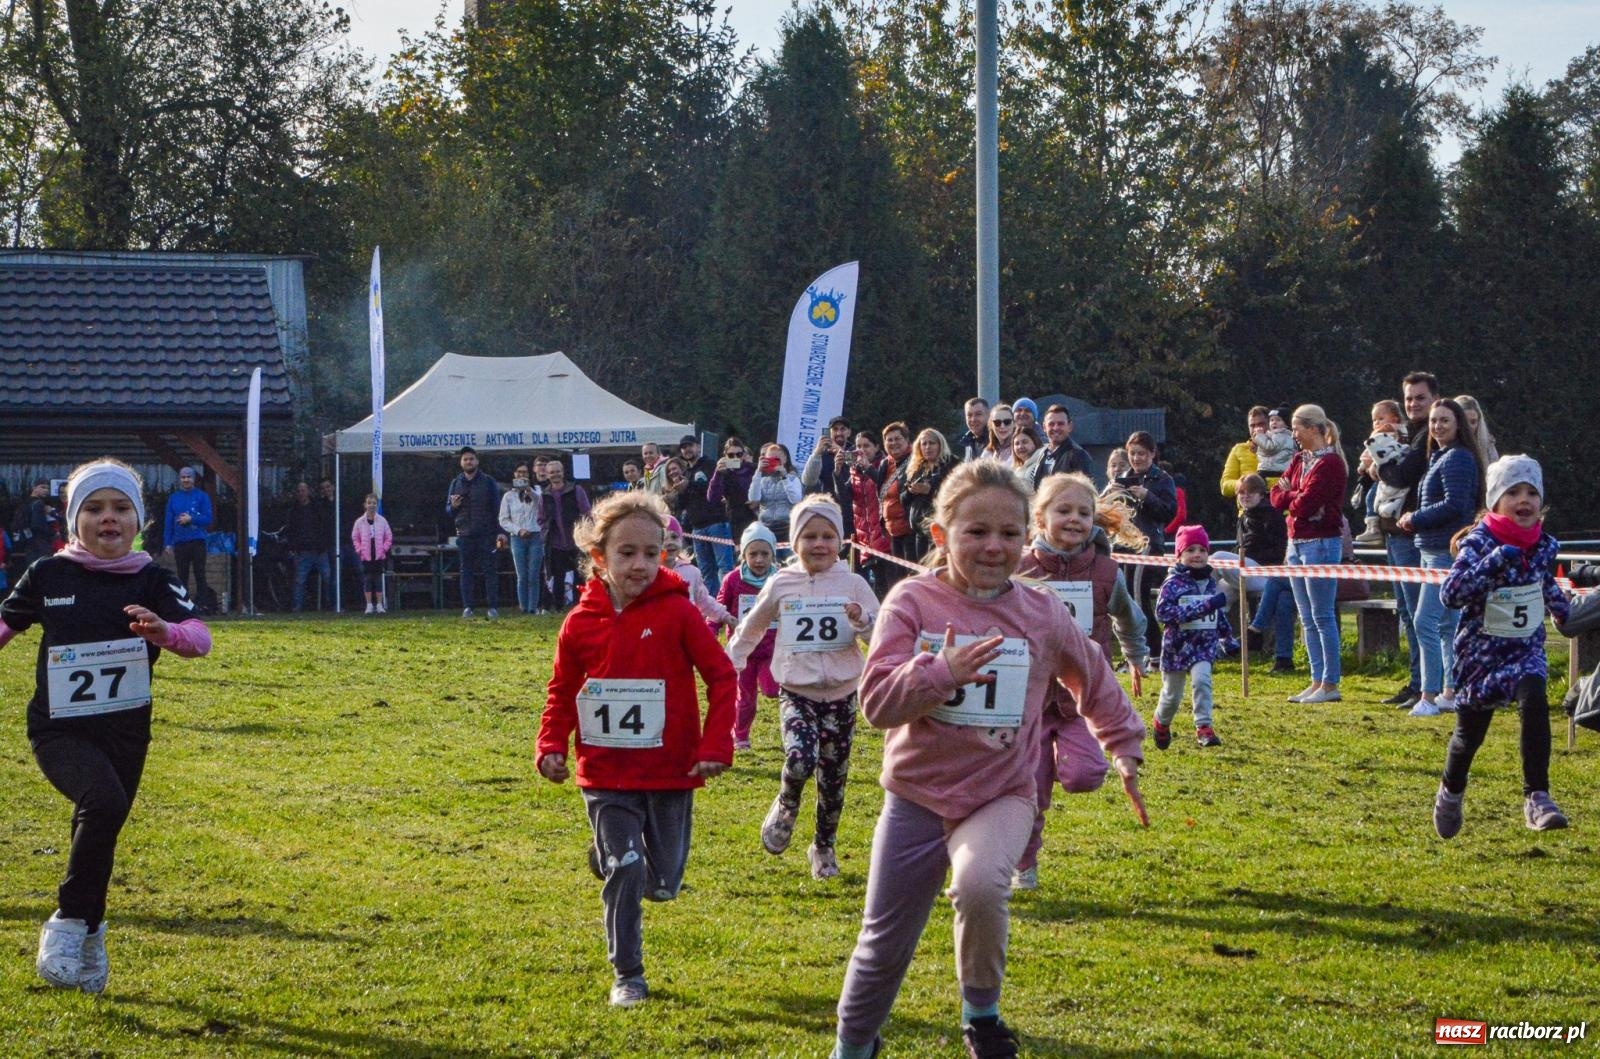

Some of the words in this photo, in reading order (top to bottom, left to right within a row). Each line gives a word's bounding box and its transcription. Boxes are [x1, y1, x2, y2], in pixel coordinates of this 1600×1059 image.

[806, 333, 829, 387] STOWARZYSZENIE
[802, 387, 821, 415] AKTYWNI
[800, 417, 817, 430] DLA
[399, 433, 477, 447] STOWARZYSZENIE
[485, 432, 524, 446] AKTYWNI
[532, 432, 549, 444] DLA
[557, 431, 601, 444] LEPSZEGO
[609, 430, 637, 443] JUTRA
[44, 595, 75, 607] hummel
[796, 616, 838, 642] 28
[1512, 605, 1528, 628] 5
[69, 666, 127, 703] 27
[594, 704, 645, 735] 14
